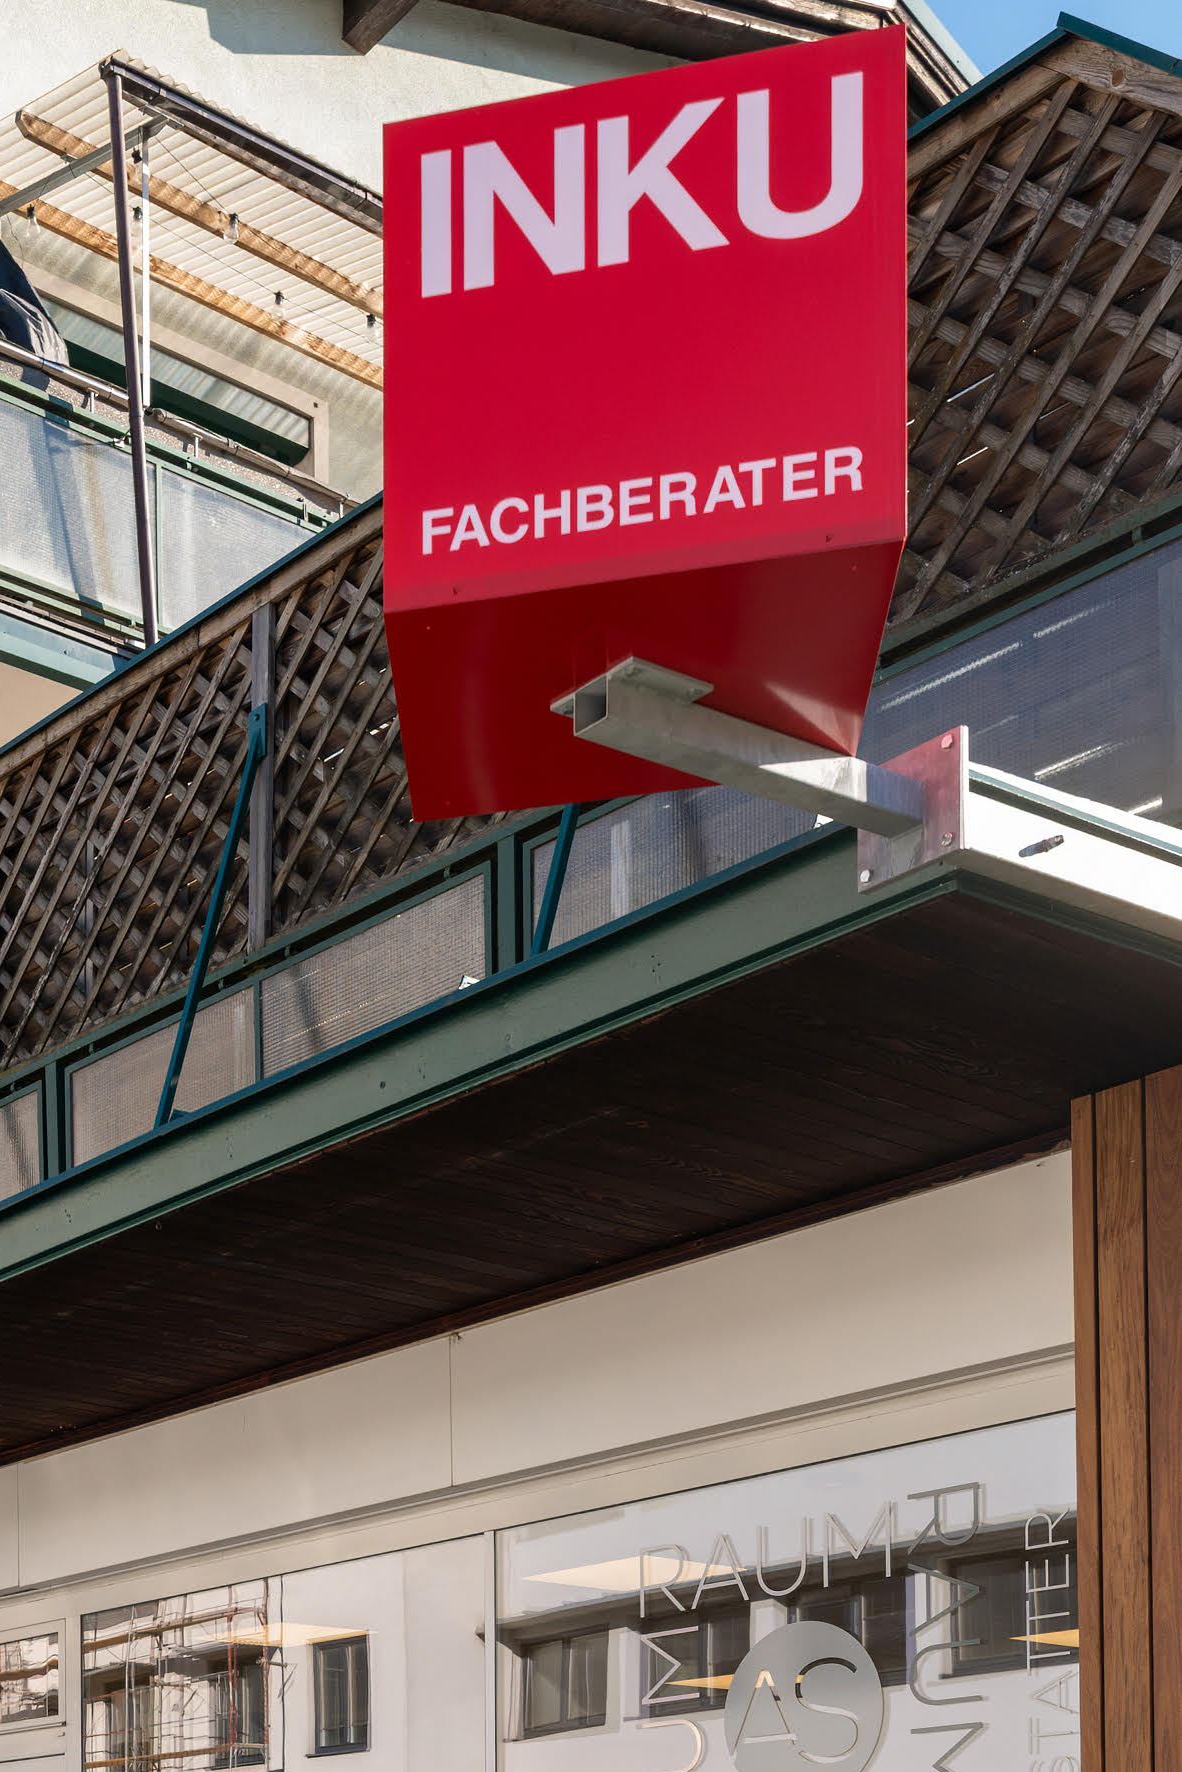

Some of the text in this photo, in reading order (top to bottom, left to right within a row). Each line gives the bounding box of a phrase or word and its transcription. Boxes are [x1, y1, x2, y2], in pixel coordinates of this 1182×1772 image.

[420, 71, 865, 299] INKU
[421, 446, 864, 555] FACHBERATER
[639, 1500, 893, 1618] RAUM
[730, 1657, 861, 1763] AS
